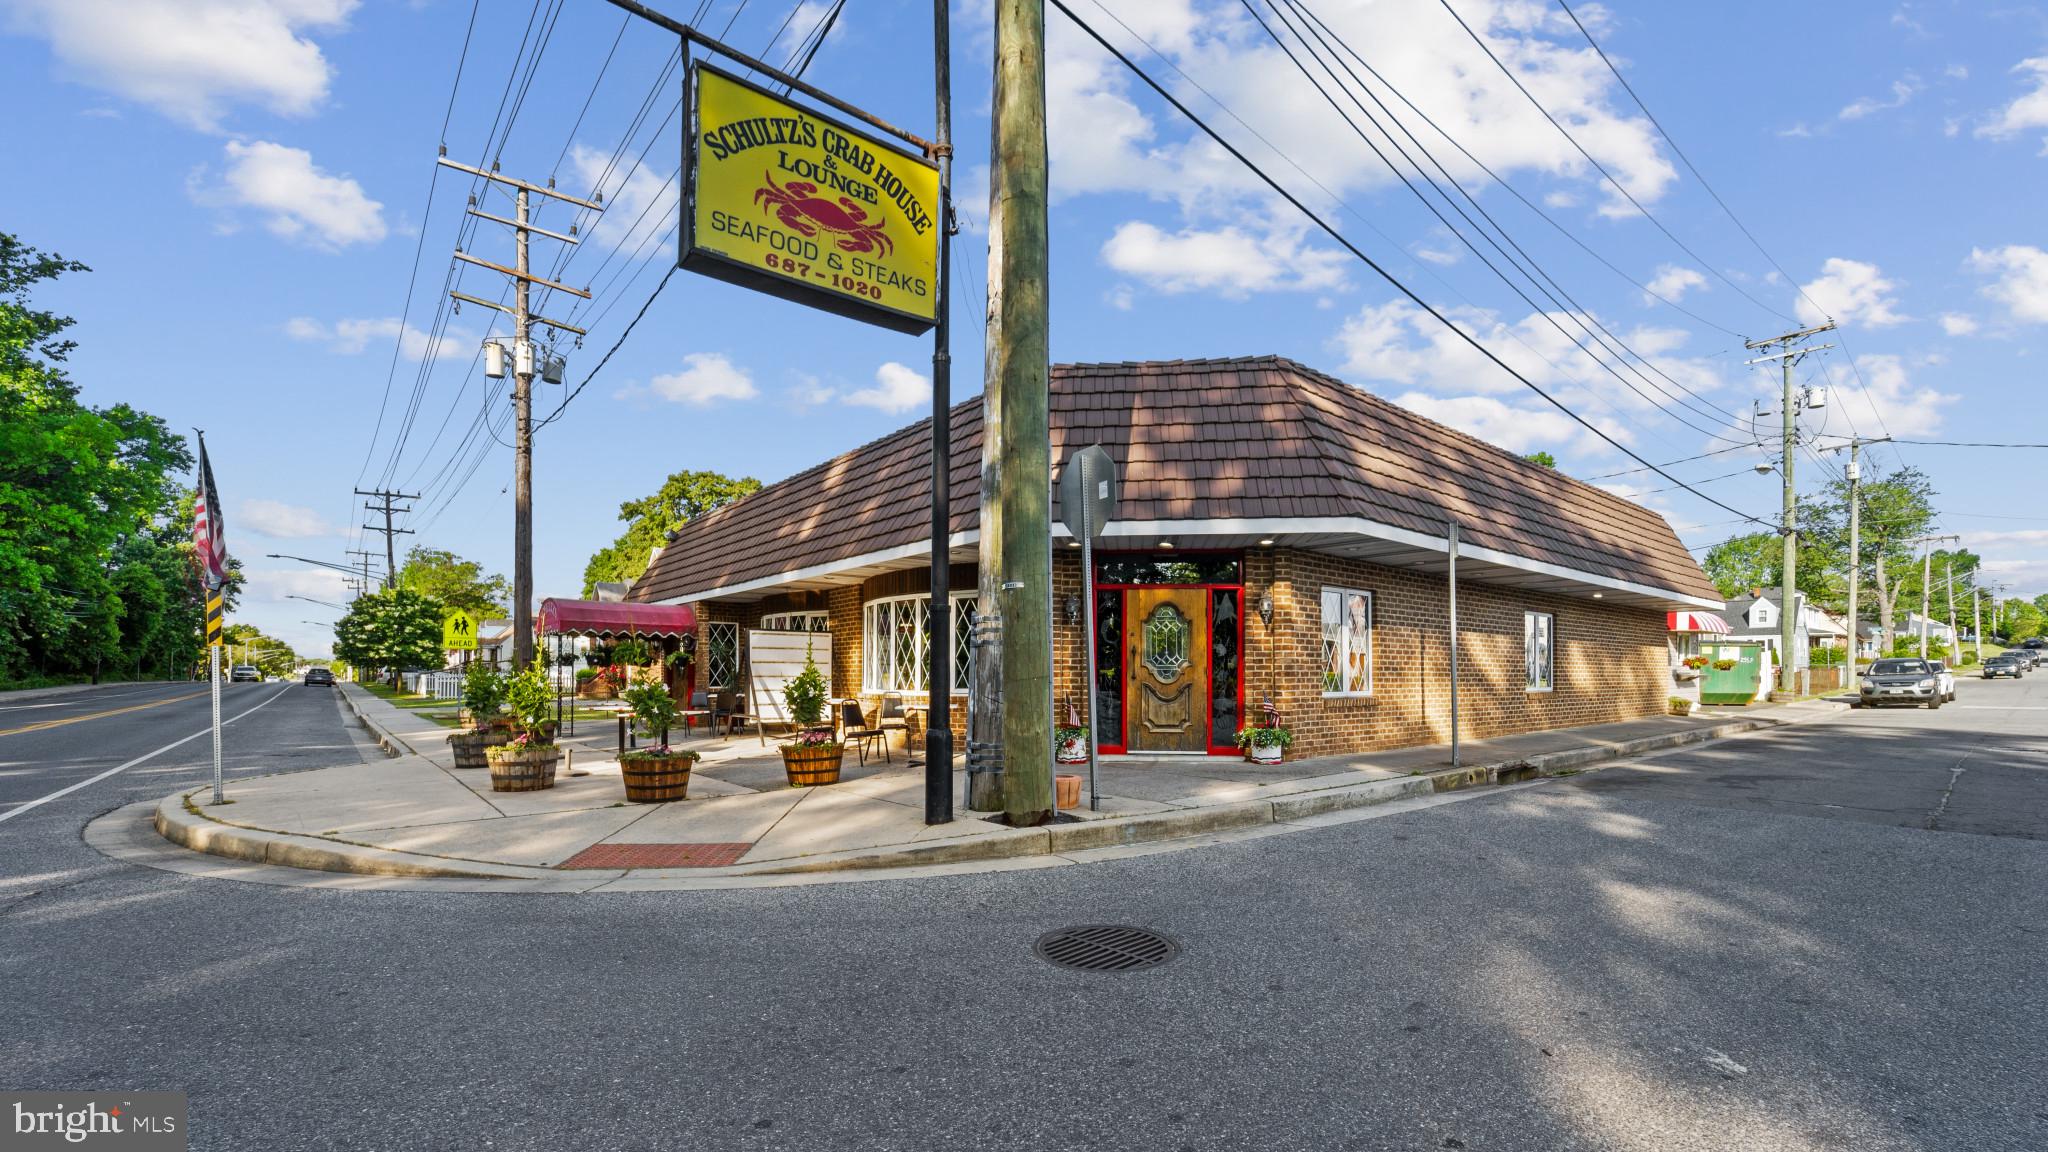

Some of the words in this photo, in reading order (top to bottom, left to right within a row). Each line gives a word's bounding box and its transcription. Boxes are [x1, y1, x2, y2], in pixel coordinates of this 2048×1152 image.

[703, 114, 817, 161] SCHULTZ'S
[822, 128, 876, 175] CRAB
[872, 163, 933, 236] HOUSE
[777, 150, 878, 205] LOUNGE
[823, 154, 838, 171] &
[711, 211, 819, 261] SEAFOOD
[827, 252, 844, 271] &
[852, 257, 927, 297] STEAKS
[448, 639, 473, 647] AHEAD
